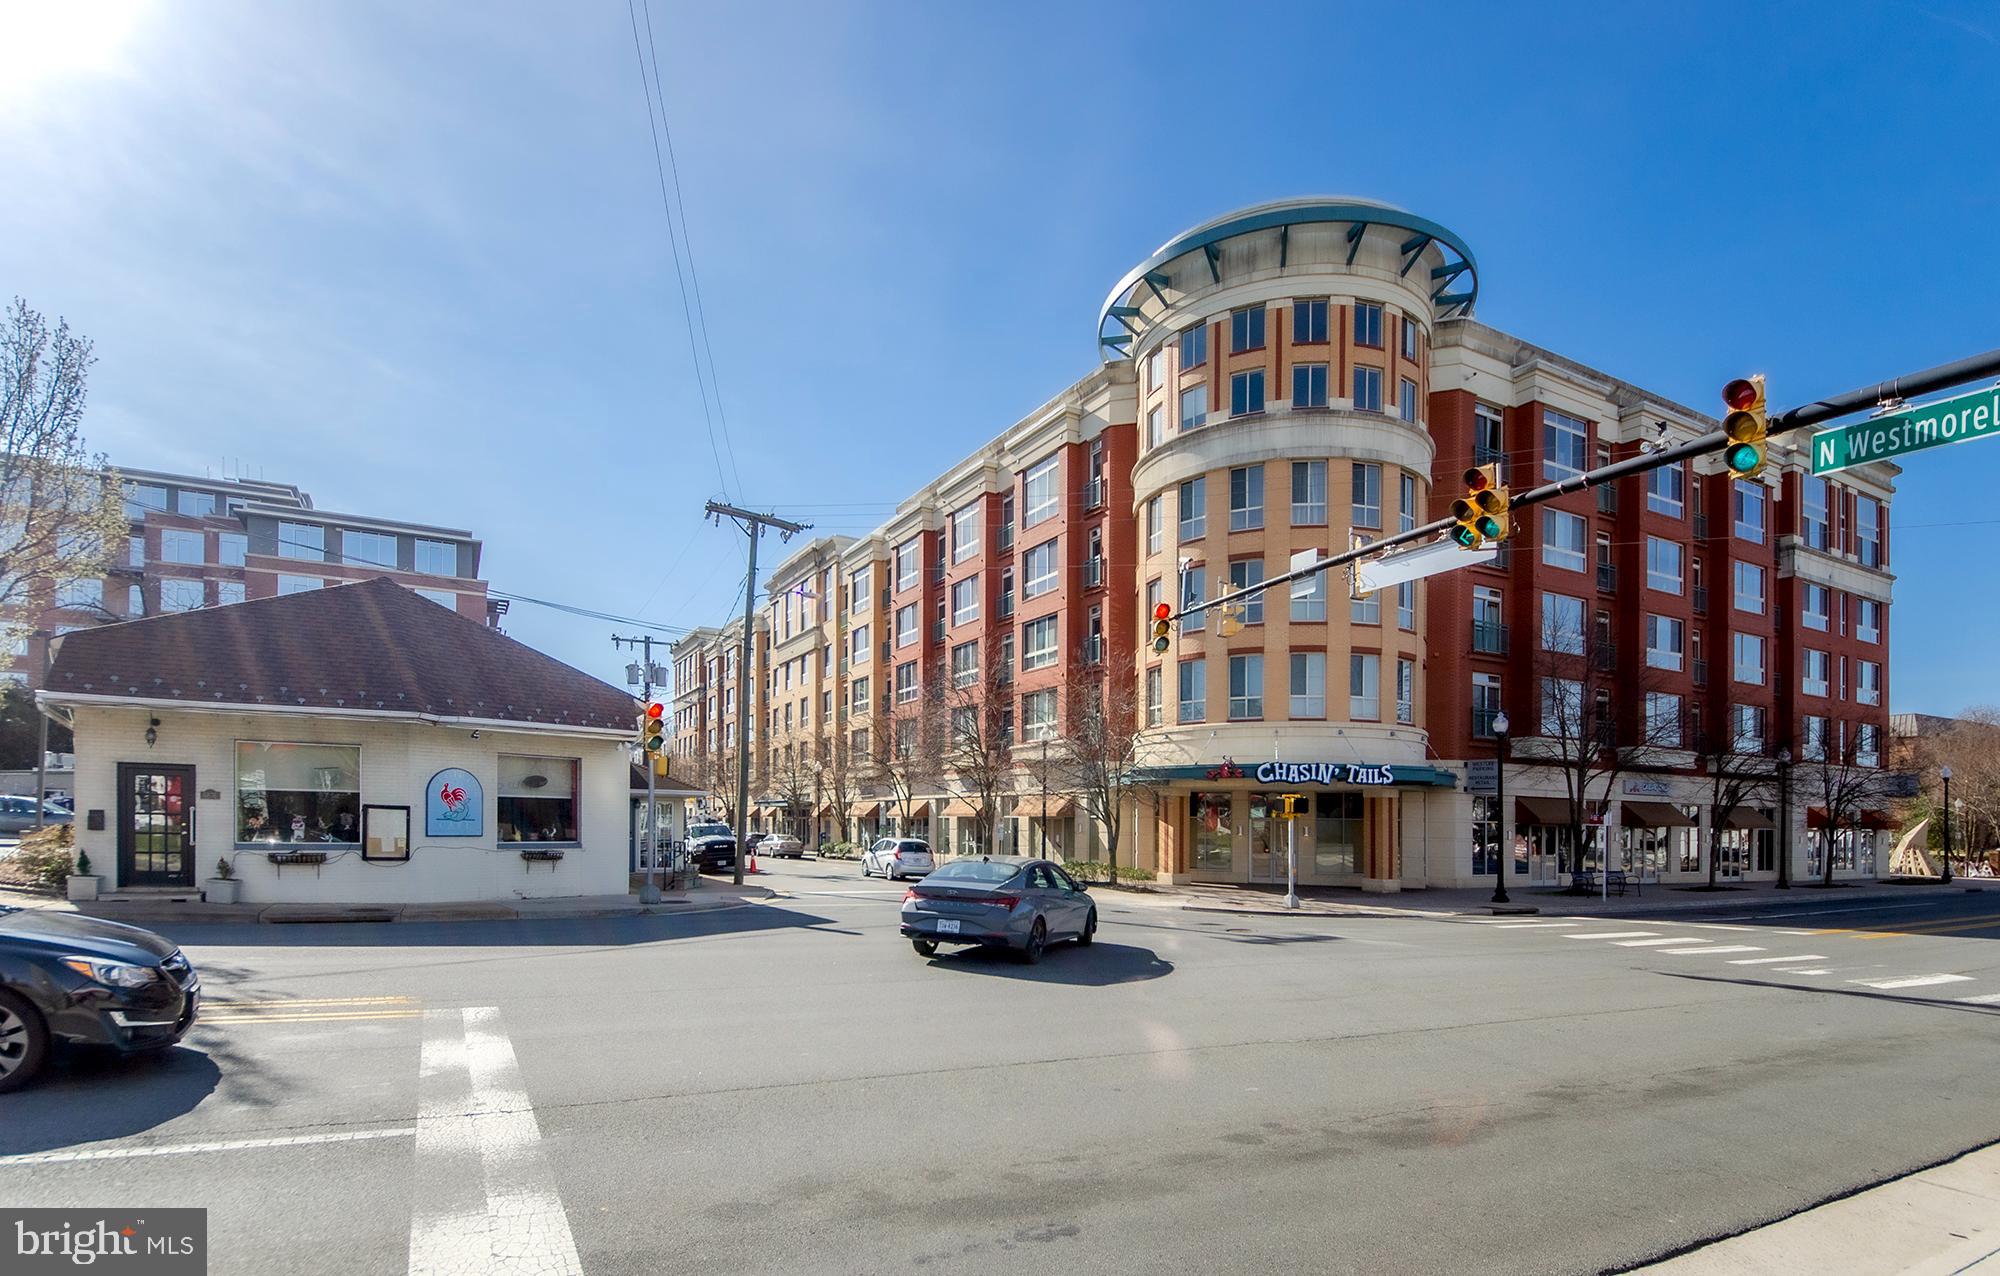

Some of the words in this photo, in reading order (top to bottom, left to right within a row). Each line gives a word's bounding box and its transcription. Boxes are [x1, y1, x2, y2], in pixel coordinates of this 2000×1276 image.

[1820, 438, 1835, 467] N
[1256, 762, 1340, 784] CHASIN'
[1346, 763, 1394, 785] TAILS
